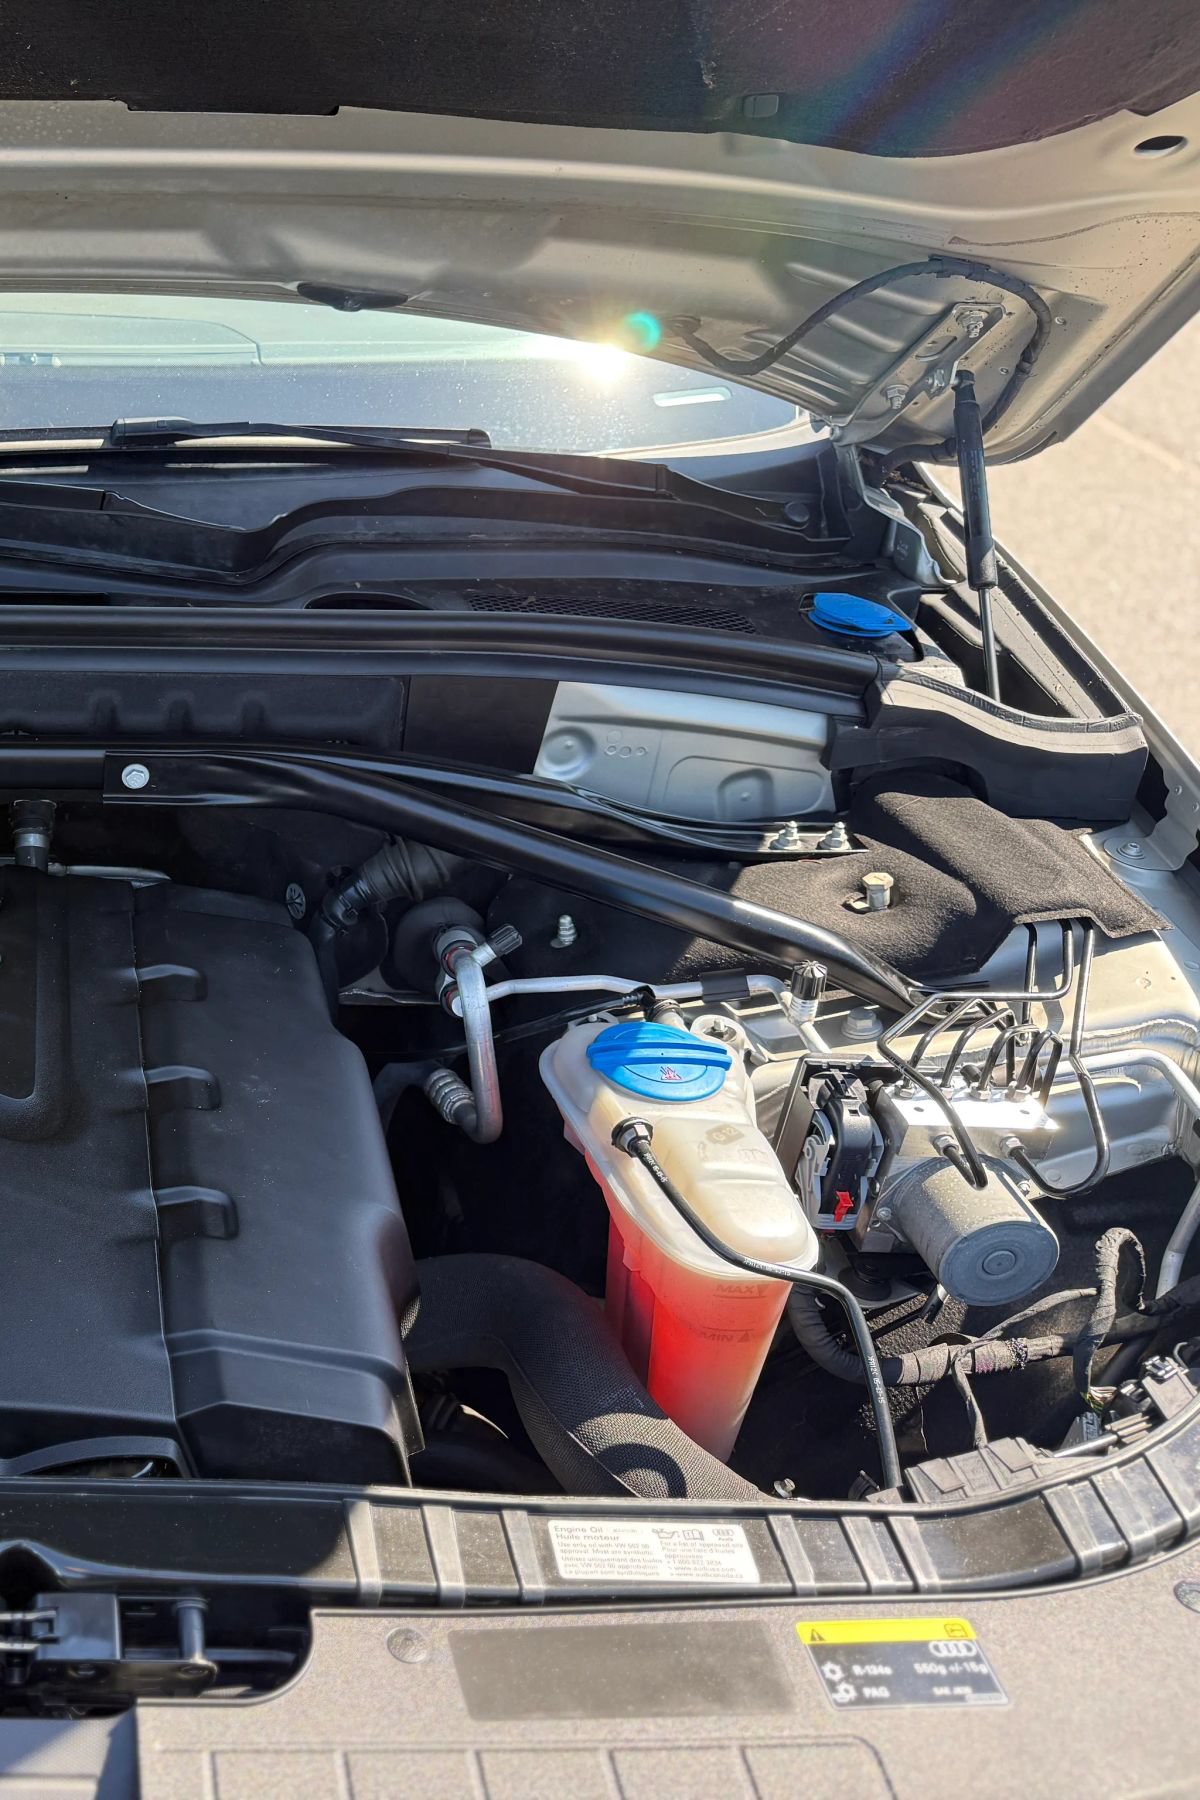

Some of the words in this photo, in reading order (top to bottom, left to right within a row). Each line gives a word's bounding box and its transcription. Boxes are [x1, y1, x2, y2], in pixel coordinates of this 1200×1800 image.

[716, 1284, 755, 1294] MAX
[553, 1525, 587, 1534] Engine
[555, 1533, 581, 1541] Huile
[852, 1664, 893, 1676] R-134a
[913, 1662, 947, 1677] 550g
[862, 1686, 890, 1699] PAG
